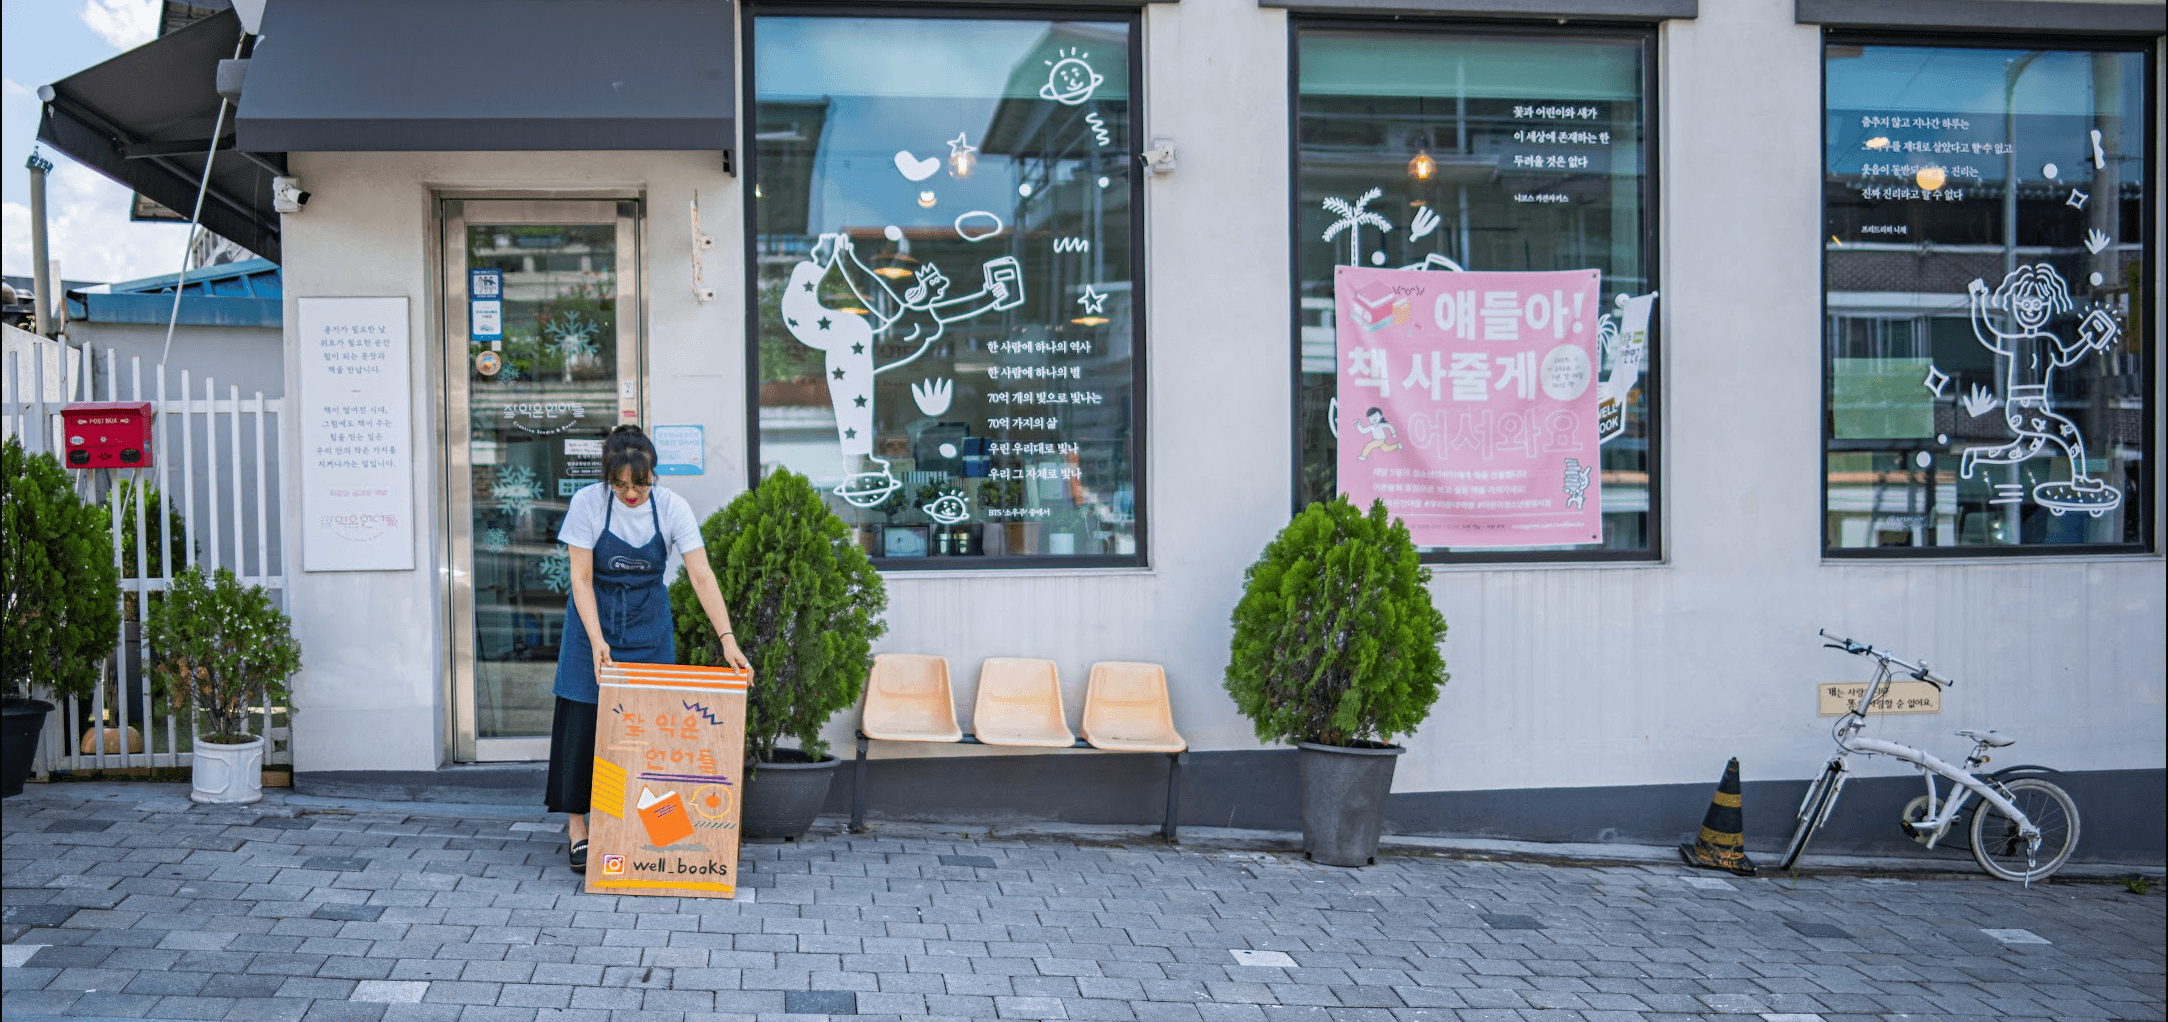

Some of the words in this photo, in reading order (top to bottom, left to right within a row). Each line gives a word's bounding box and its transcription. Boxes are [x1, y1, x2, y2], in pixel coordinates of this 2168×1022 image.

[1513, 106, 1534, 120] 꽃과
[1536, 106, 1576, 120] 어린이와
[1577, 106, 1598, 120] 새가
[1861, 116, 1889, 129] 춤추지
[1891, 116, 1910, 129] 않고
[1912, 116, 1940, 129] 지나간
[1942, 116, 1970, 129] 하루는
[1513, 130, 1524, 144] 이
[1526, 130, 1556, 144] 세상에
[1558, 130, 1597, 144] 존재하는
[1599, 130, 1610, 144] 한
[1903, 141, 1932, 153] 제대로
[1932, 142, 1970, 154] 살았다고
[1982, 143, 1992, 154] 수
[1994, 143, 2013, 155] 없고
[1513, 155, 1544, 168] 두려울
[1546, 155, 1566, 168] 것은
[1568, 155, 1589, 168] 없다
[1861, 164, 1889, 176] 웃음이
[1951, 166, 1979, 177] 진리는
[1861, 188, 1881, 200] 진짜
[1882, 189, 1920, 200] 진리라고
[1933, 190, 1943, 200] 수
[1944, 189, 1963, 201] 없다
[324, 325, 348, 334] 용기가
[351, 325, 375, 334] 필요한
[320, 338, 345, 348] 위로가
[347, 338, 371, 348] 필요한
[987, 341, 998, 354] 한
[1000, 341, 1033, 354] 사람에
[1035, 341, 1067, 354] 하나의
[1069, 341, 1092, 354] 역사
[324, 352, 338, 361] 힘이
[341, 352, 358, 361] 되는
[328, 365, 343, 374] 책을
[346, 365, 381, 374] 만납니다.
[987, 366, 998, 379] 한
[1000, 366, 1033, 379] 사람에
[1035, 366, 1067, 379] 하나의
[1070, 366, 1081, 379] 별
[1347, 348, 1390, 402] 책
[1402, 348, 1537, 402] 사줄게
[987, 391, 1009, 405] 70억
[1012, 391, 1033, 405] 개의
[1036, 391, 1068, 405] 빛으로
[1070, 391, 1102, 405] 빛나는
[324, 406, 338, 414] 책이
[1600, 403, 1618, 419] ELL
[322, 419, 354, 428] 그럼에도
[358, 419, 373, 428] 책이
[376, 419, 392, 428] 주는
[987, 416, 1009, 430] 70억
[1012, 416, 1044, 430] 가지의
[1600, 415, 1619, 434] OOK
[1408, 408, 1584, 461] 어서와요
[316, 446, 331, 455] 우리
[335, 446, 351, 455] 안의
[354, 446, 370, 455] 작은
[373, 446, 397, 455] 가치를
[988, 442, 1010, 455] 우린
[1012, 442, 1055, 455] 우리대로
[1057, 442, 1079, 455] 빛나
[988, 467, 1010, 481] 우리
[1012, 467, 1024, 481] 그
[1026, 467, 1058, 481] 자체로
[1060, 467, 1082, 481] 빛나
[988, 508, 1002, 517] BTS
[1907, 698, 1933, 709] 없어요.
[621, 712, 646, 737] 잘
[655, 712, 700, 740] 익은
[645, 746, 719, 775] 언어들
[633, 857, 727, 876] well_books
